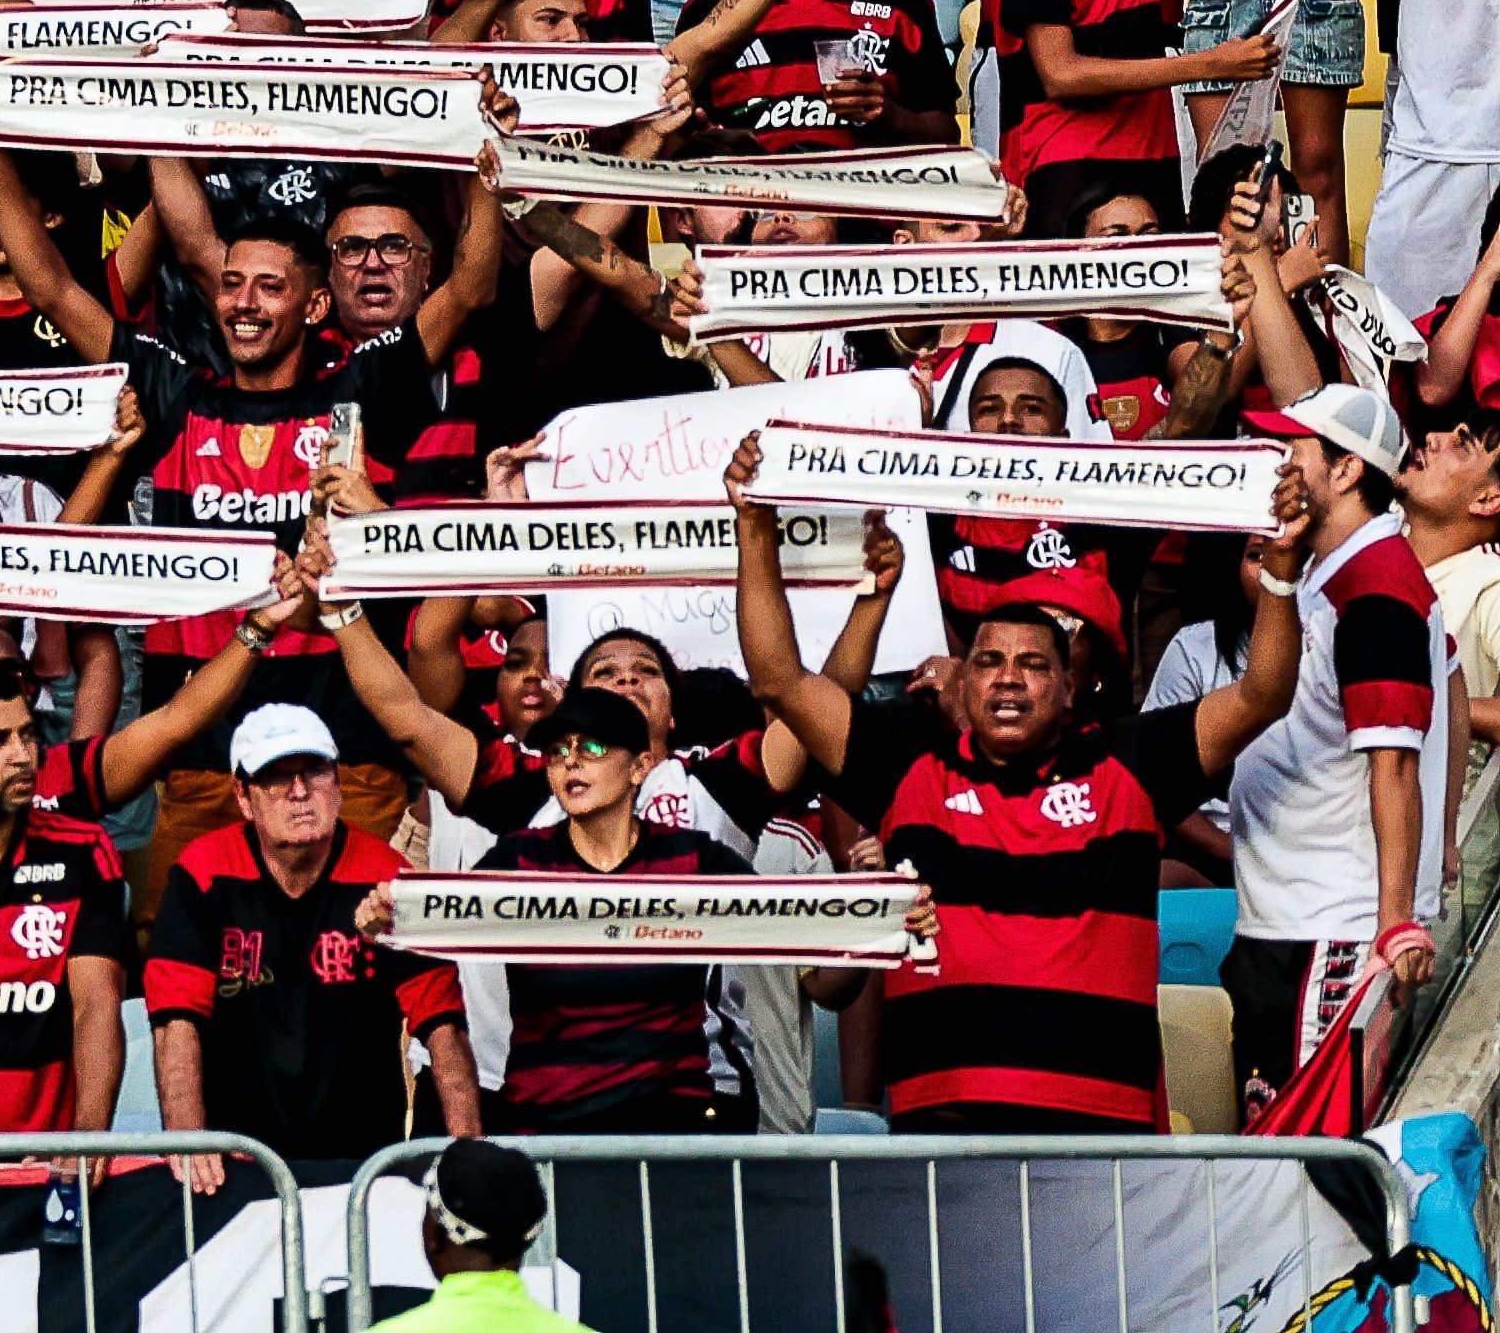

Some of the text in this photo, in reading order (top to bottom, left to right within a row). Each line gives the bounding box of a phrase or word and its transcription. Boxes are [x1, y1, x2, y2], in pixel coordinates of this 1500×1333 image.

[731, 260, 1188, 298] PRA CIMA DELES, FLAMENGO!
[424, 895, 890, 920] PRA CIMA DELES, FLAMENGO!
